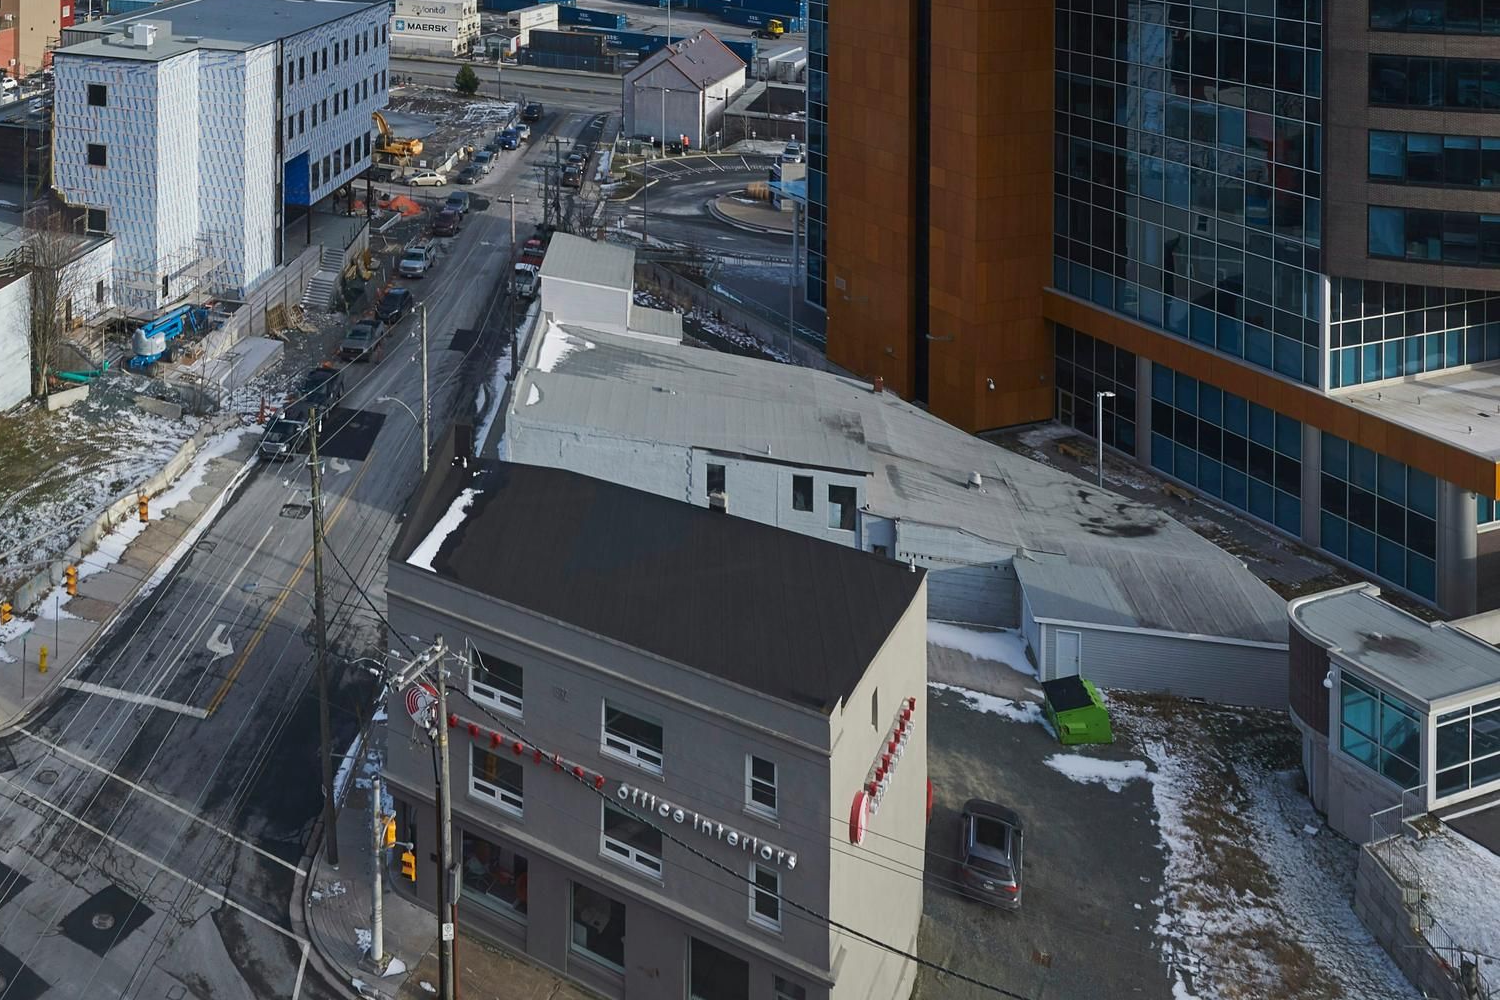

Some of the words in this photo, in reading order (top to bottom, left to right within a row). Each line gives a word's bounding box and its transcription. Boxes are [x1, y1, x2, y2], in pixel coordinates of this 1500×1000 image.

[407, 22, 448, 33] MAERSK
[617, 785, 685, 824] office
[693, 813, 798, 871] interiors
